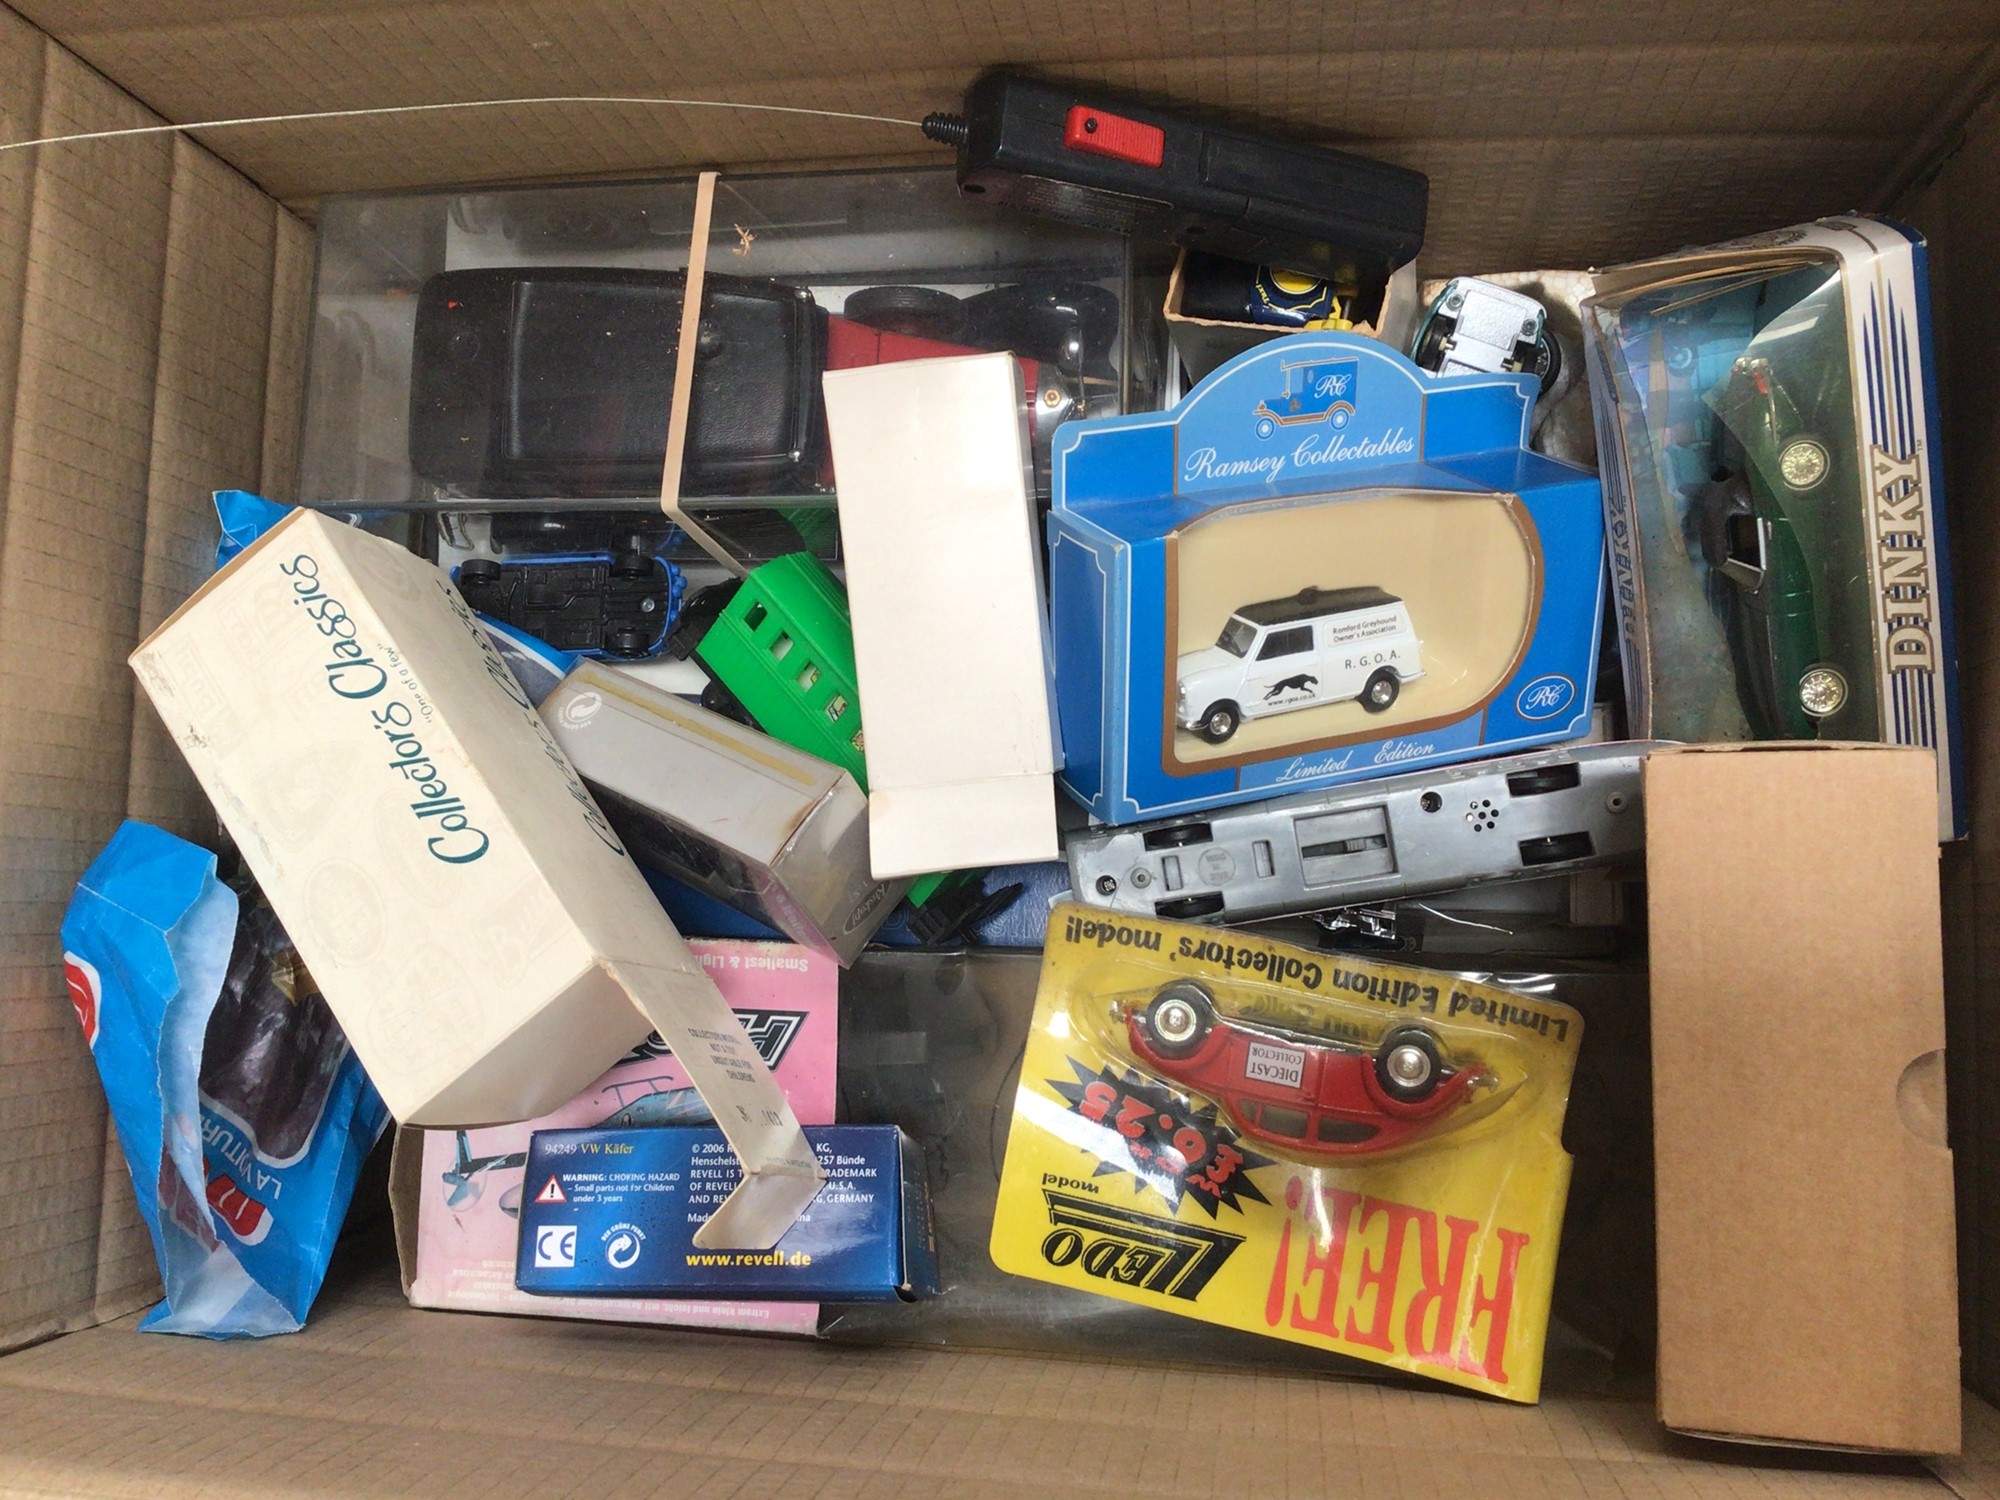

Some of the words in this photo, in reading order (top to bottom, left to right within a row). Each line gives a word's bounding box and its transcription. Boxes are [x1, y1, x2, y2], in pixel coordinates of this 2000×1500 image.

[1184, 446, 1286, 483] Ramsey
[1290, 427, 1415, 468] Collectables
[1869, 443, 1937, 675] DINKY
[280, 554, 388, 699] Classics
[1332, 622, 1361, 635] Romford
[1361, 615, 1398, 631] Greyhound
[1333, 631, 1361, 644] Owner's
[1361, 624, 1397, 640] Association
[398, 667, 408, 676] a
[402, 676, 418, 691] of
[1275, 750, 1354, 783] Limited
[1374, 740, 1436, 765] Edition
[371, 701, 490, 864] Collector's
[1066, 914, 1162, 951] model!
[729, 956, 740, 968] &
[744, 955, 808, 973] Smallest
[1170, 933, 1324, 989] Collectors'
[1332, 967, 1440, 1012] Edition
[1447, 992, 1570, 1043] Limited
[1250, 1045, 1305, 1066] COLLECTOR
[1249, 1060, 1300, 1083] DIECAST
[544, 1143, 577, 1155] 94249
[580, 1143, 601, 1154] VW
[604, 1142, 636, 1155] Käfer
[702, 1143, 725, 1153] 2006
[816, 1142, 833, 1154] KG,
[836, 1155, 866, 1165] Bünde
[562, 1173, 607, 1182] WARNING:
[608, 1173, 646, 1182] CHOKING
[648, 1173, 680, 1181] HAZARD
[690, 1169, 722, 1179] REVELL
[726, 1169, 734, 1178] IS
[826, 1168, 877, 1178] RADEMARK
[1042, 1172, 1099, 1195] model
[257, 1169, 282, 1200] LA
[574, 1183, 594, 1192] Small
[595, 1184, 615, 1194] parts
[615, 1184, 629, 1192] not
[630, 1183, 641, 1192] for
[643, 1183, 675, 1192] Children
[689, 1182, 702, 1191] OF
[828, 1181, 857, 1190] U.S.A.
[573, 1194, 595, 1203] under
[597, 1194, 602, 1203] 3
[602, 1195, 623, 1205] years
[688, 1194, 710, 1204] AND
[686, 1251, 812, 1268] www.revell.de
[1265, 1176, 1530, 1384] FREE!
